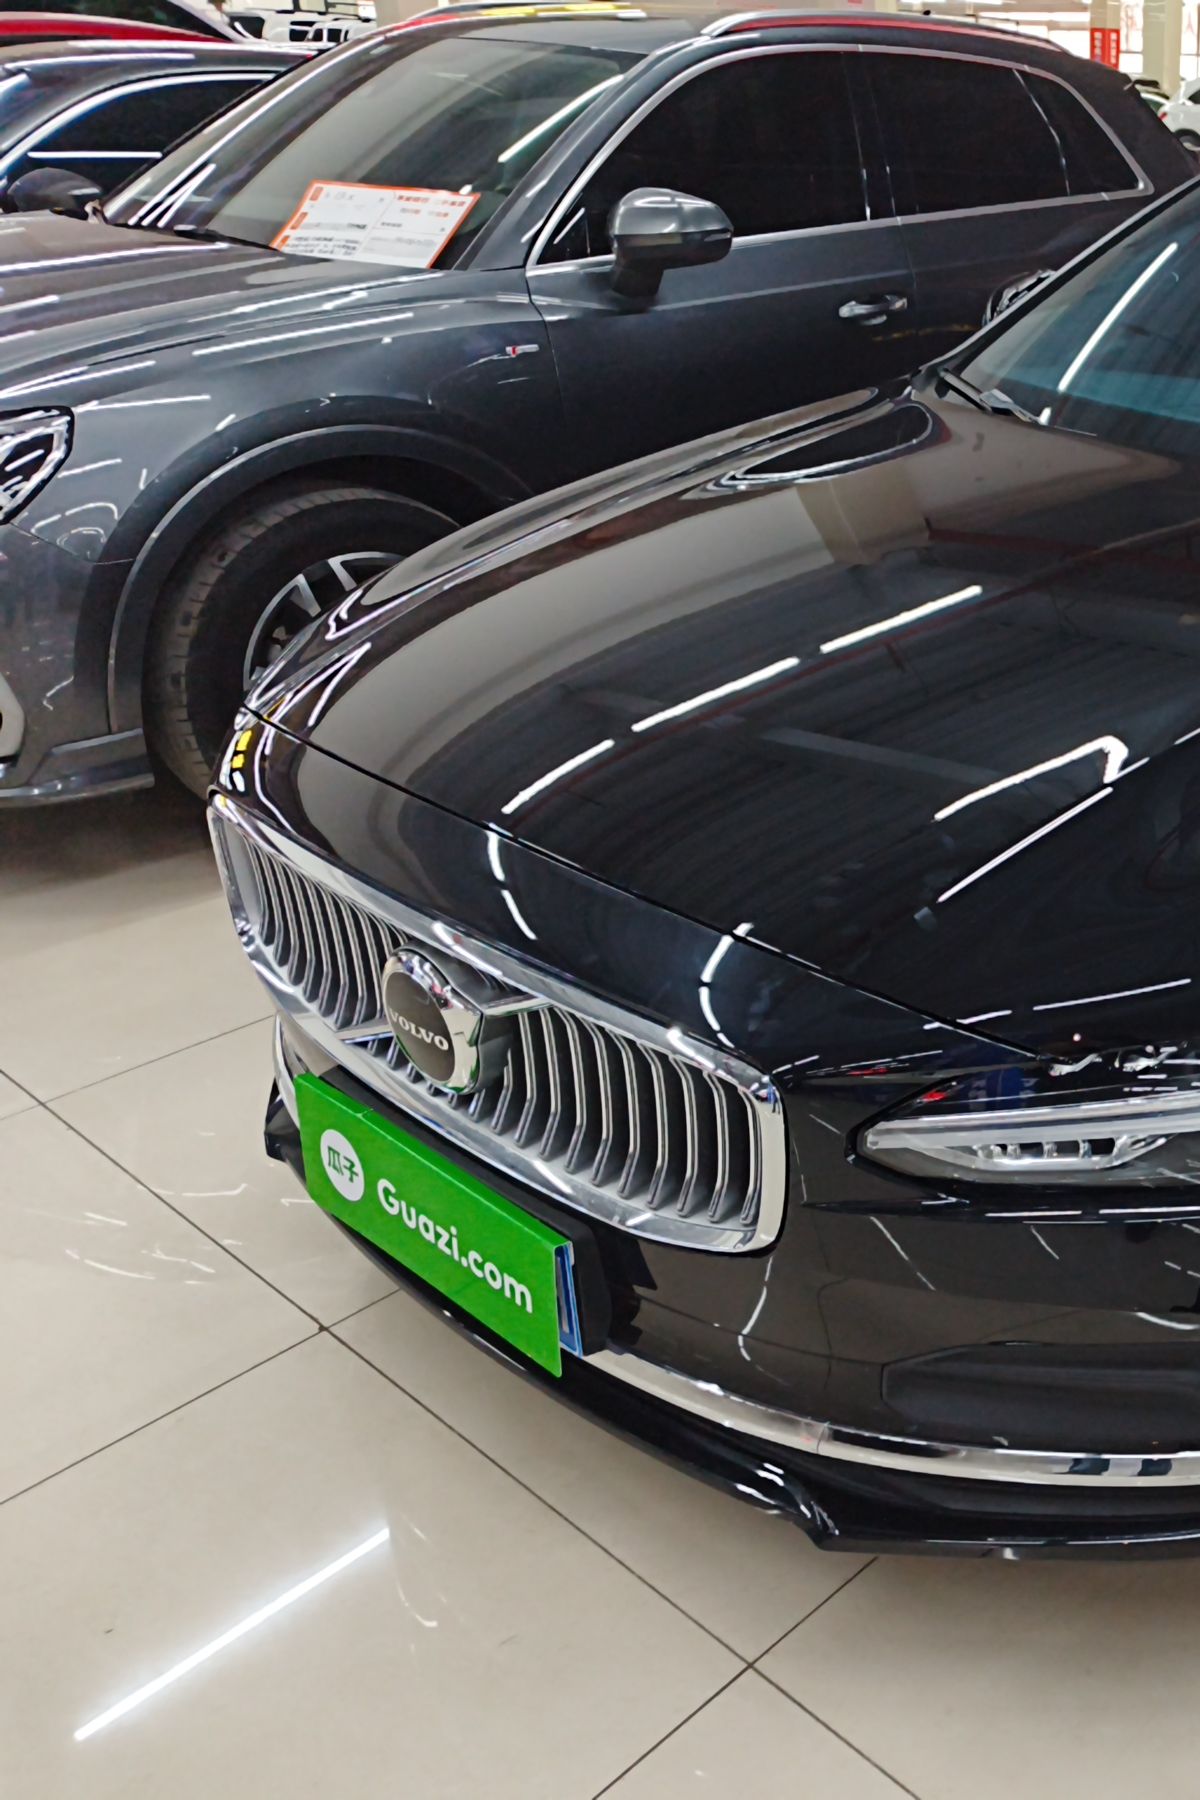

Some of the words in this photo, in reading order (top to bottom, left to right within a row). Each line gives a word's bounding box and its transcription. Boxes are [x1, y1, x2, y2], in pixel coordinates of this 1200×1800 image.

[389, 1008, 449, 1051] VOLVO
[327, 1145, 359, 1183] 瓜子
[378, 1179, 532, 1313] Guazi.com
